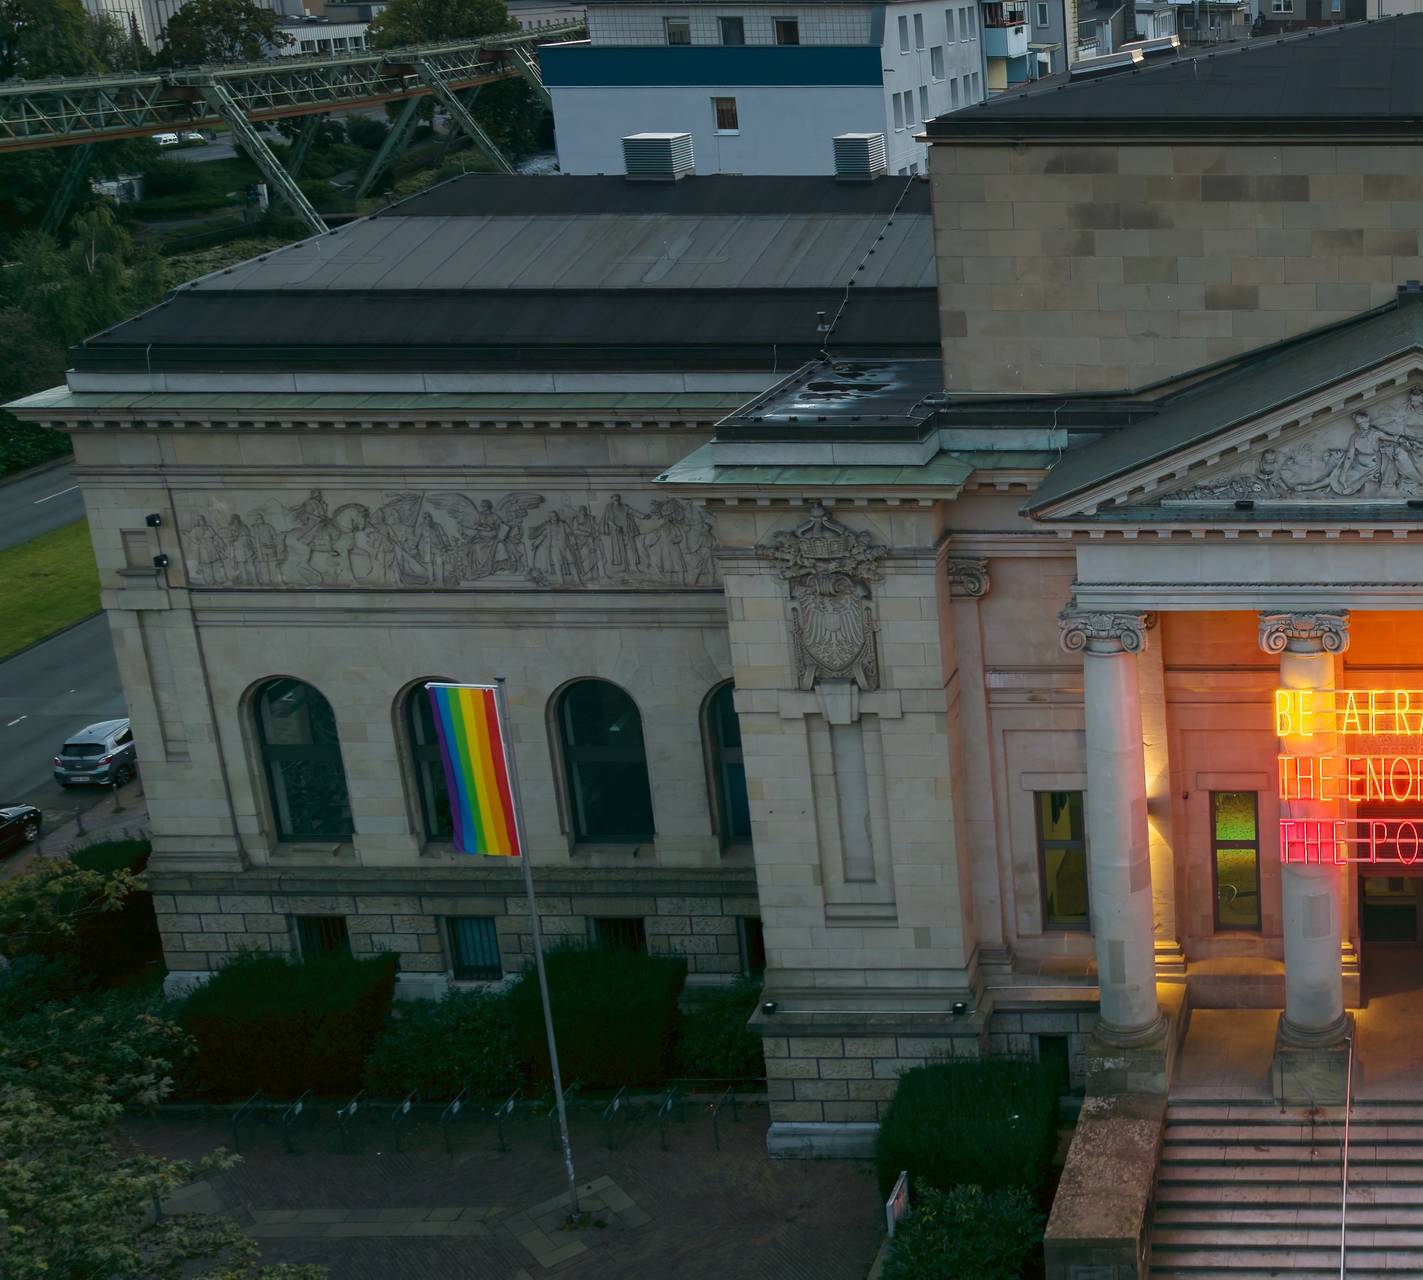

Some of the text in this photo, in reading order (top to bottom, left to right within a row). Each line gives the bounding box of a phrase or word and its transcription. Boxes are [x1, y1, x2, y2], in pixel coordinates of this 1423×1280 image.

[1276, 689, 1313, 737] BE
[1278, 756, 1334, 801] THE
[1280, 821, 1347, 865] THE
